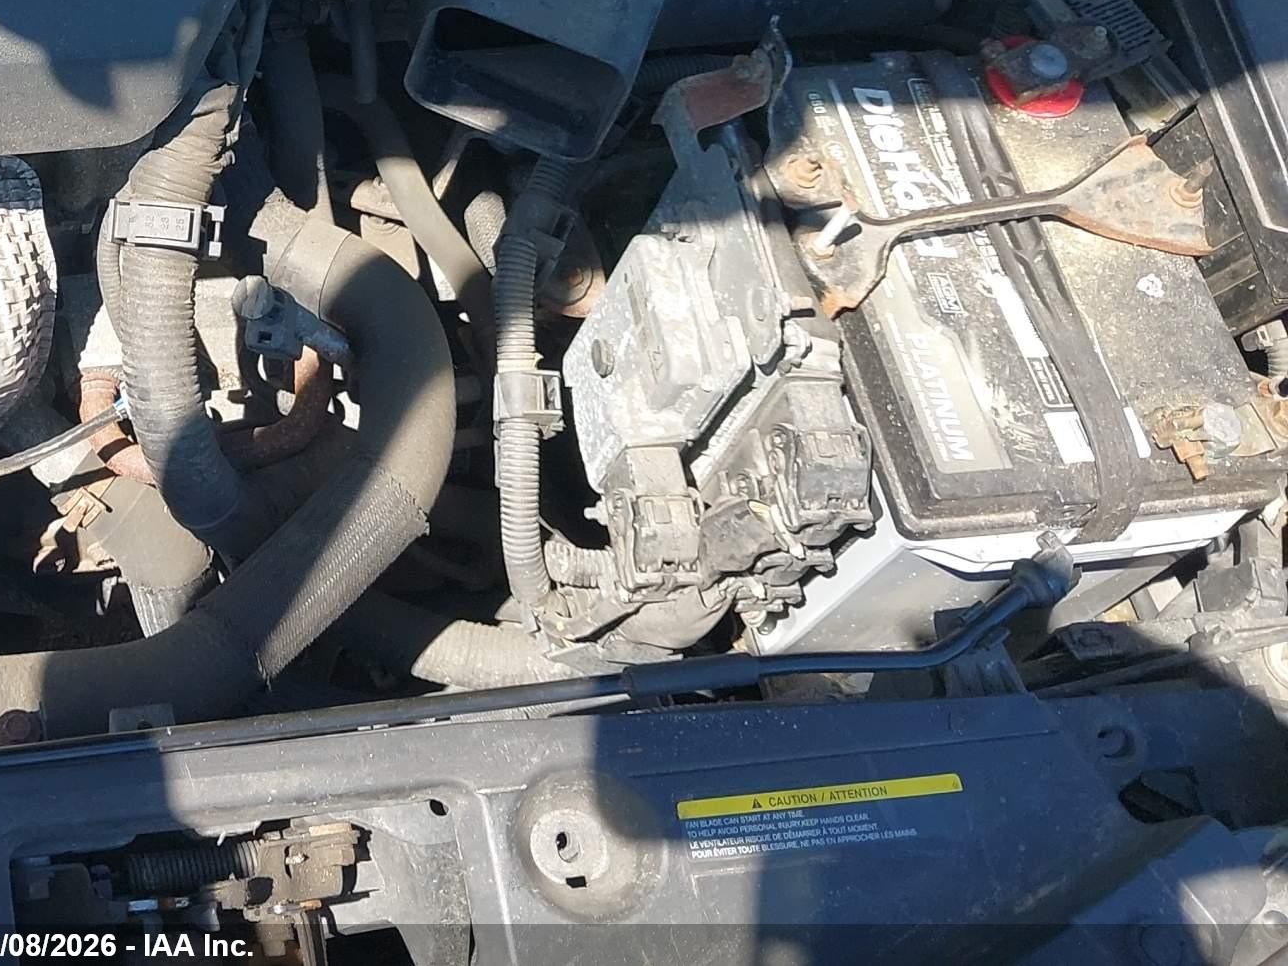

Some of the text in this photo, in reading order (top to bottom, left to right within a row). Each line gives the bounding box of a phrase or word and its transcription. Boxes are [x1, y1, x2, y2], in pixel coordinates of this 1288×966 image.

[907, 333, 976, 461] PLATINUM
[768, 793, 817, 808] CAUTION
[829, 785, 888, 802] ATTENTION
[723, 817, 739, 825] CAN
[739, 815, 761, 824] START
[772, 812, 786, 820] ANY
[698, 829, 716, 837] HELP
[717, 827, 739, 836] AVOID
[740, 824, 777, 833] PERSONAL
[772, 833, 782, 841] DE
[829, 825, 846, 835] TOUT
[692, 849, 713, 859] POUR
[737, 844, 761, 854] TOUTE
[811, 837, 825, 846] PAS
